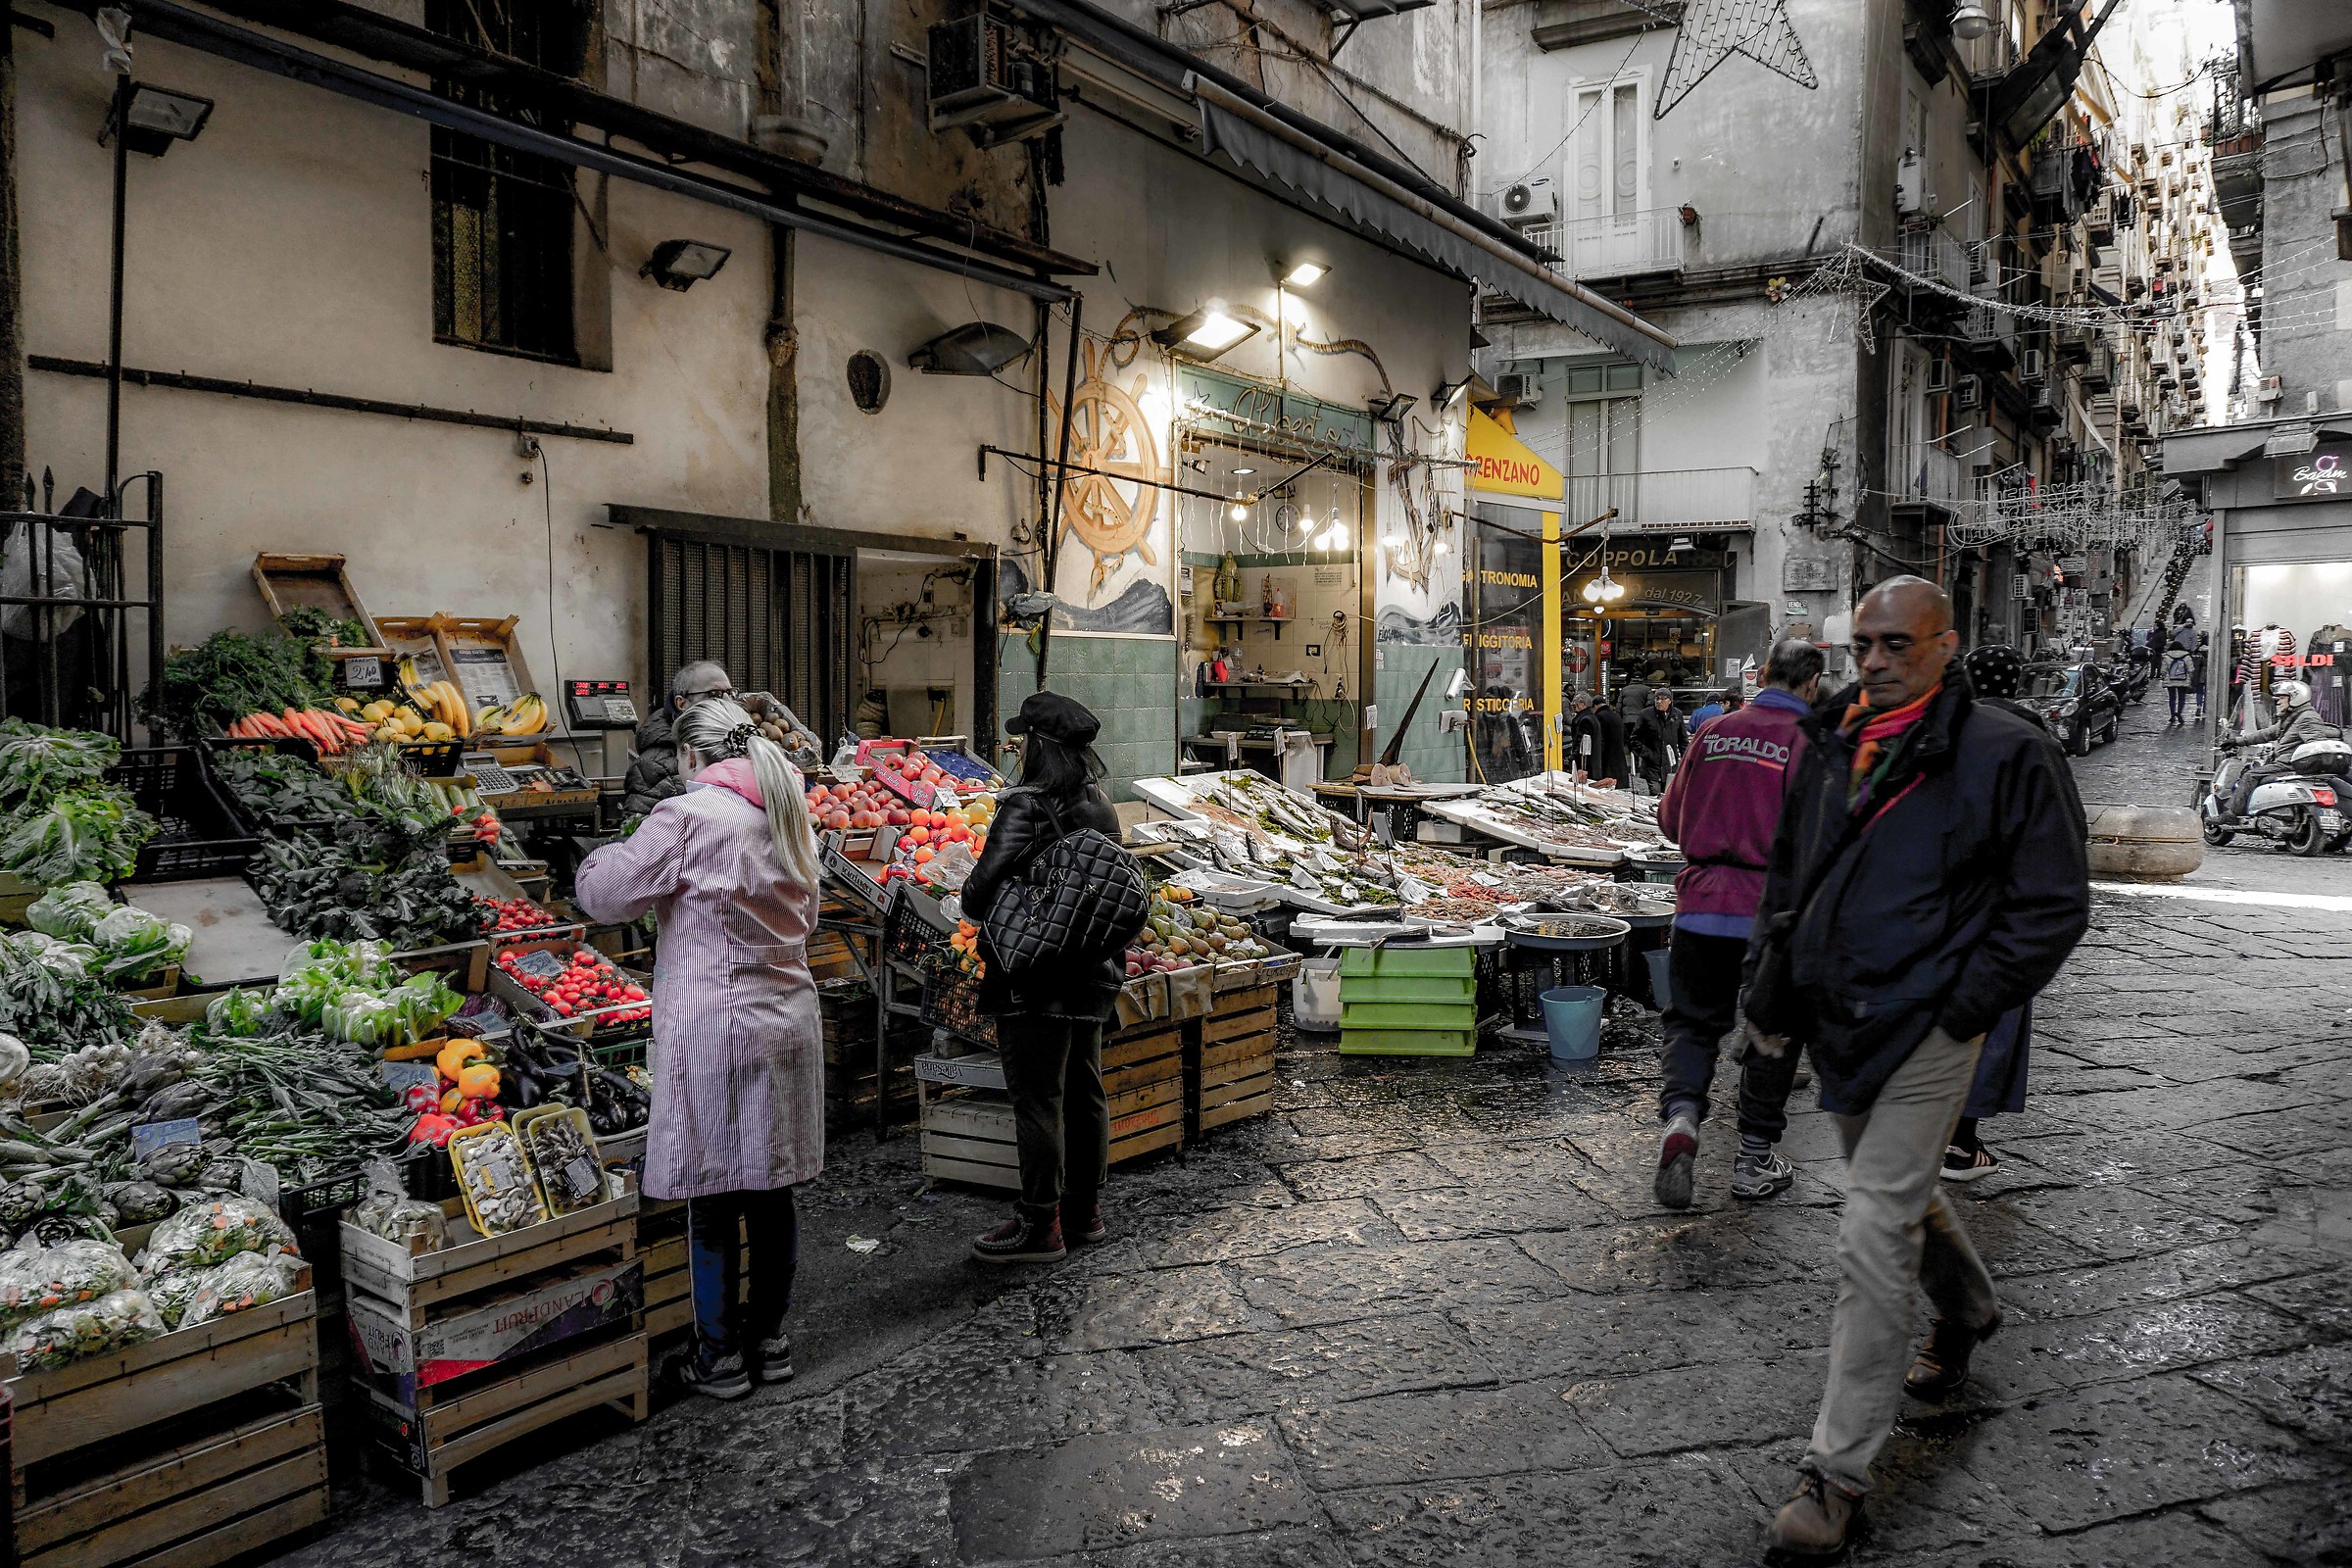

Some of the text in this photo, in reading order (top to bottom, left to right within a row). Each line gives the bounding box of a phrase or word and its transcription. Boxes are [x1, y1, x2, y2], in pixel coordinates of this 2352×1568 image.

[1566, 549, 1678, 568] COPPOLA
[1461, 568, 1538, 588] GATRONOMIA
[1644, 587, 1667, 600] dal
[1670, 589, 1703, 606] 1927
[1463, 633, 1533, 650] FIGGITORIA
[2270, 654, 2335, 666] SALDI
[1463, 698, 1535, 711] RSTICCERIA
[1703, 737, 1790, 763] TORALDO
[492, 1290, 588, 1334] LANDFRUIT
